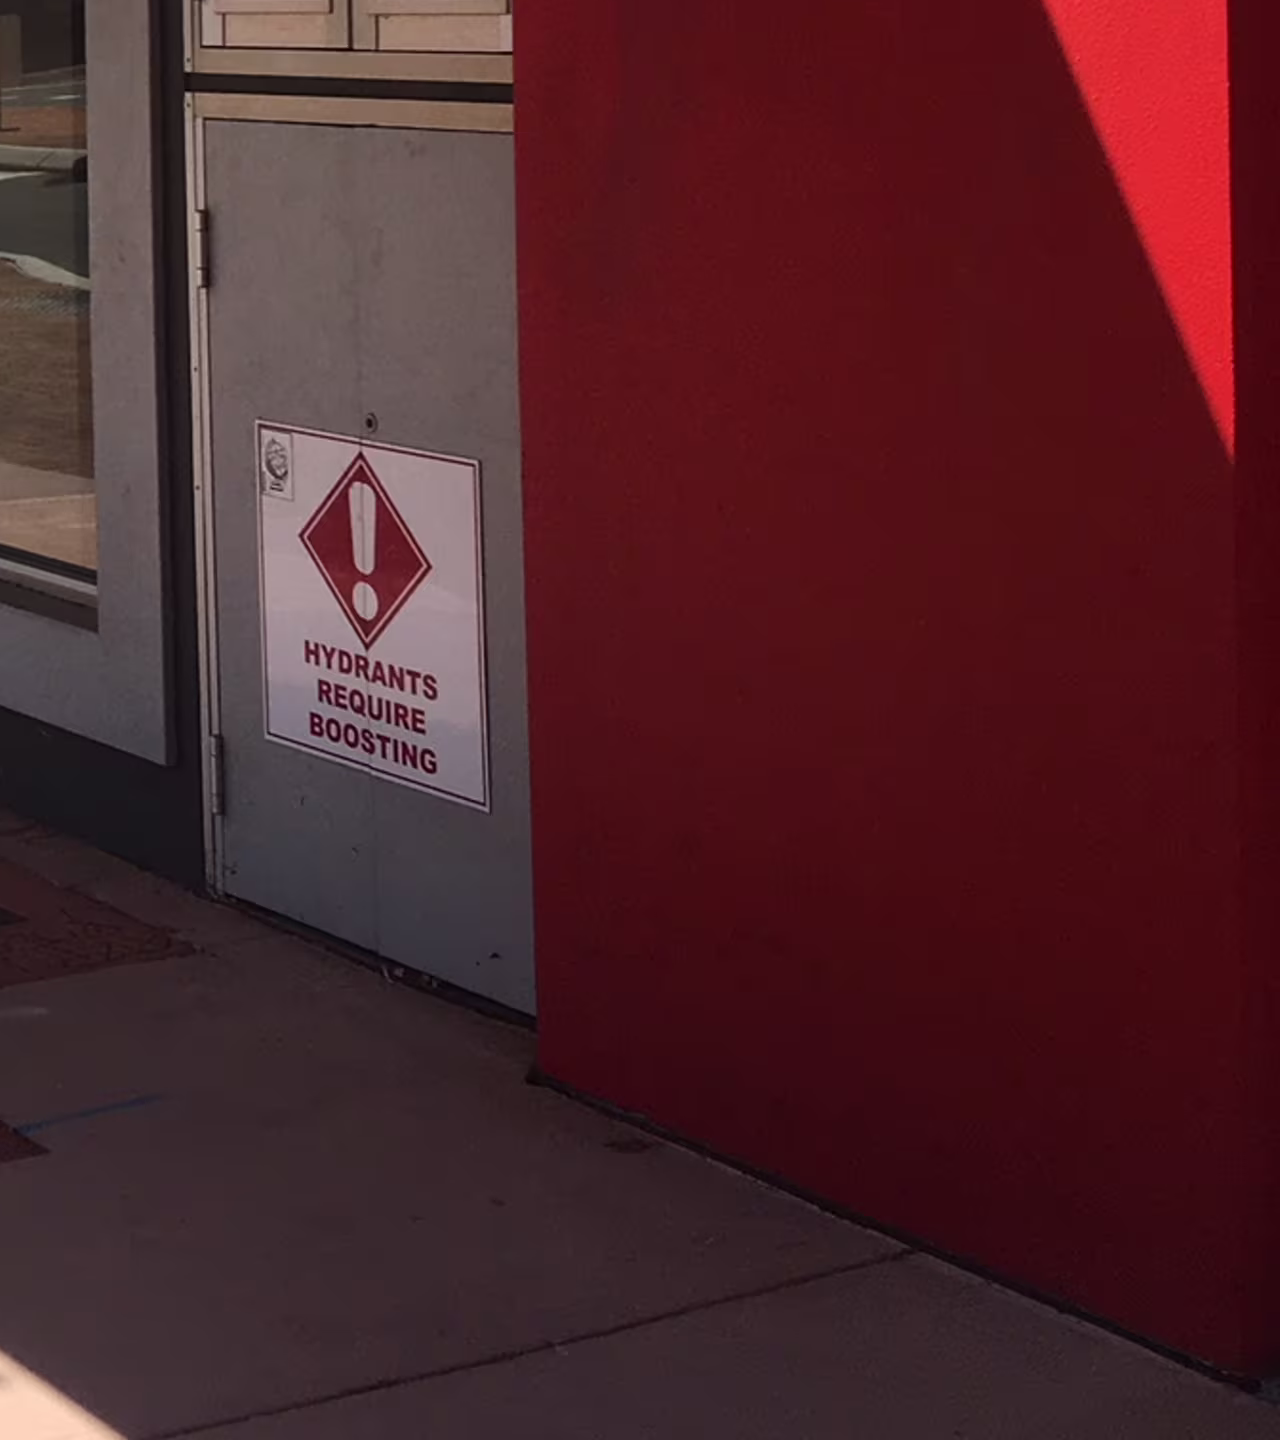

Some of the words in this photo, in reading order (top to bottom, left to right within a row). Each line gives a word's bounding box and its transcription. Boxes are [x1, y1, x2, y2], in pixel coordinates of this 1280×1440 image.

[304, 639, 439, 701] HYDRANTS
[317, 678, 427, 736] REQUIRE
[309, 711, 438, 776] BOOSTING
